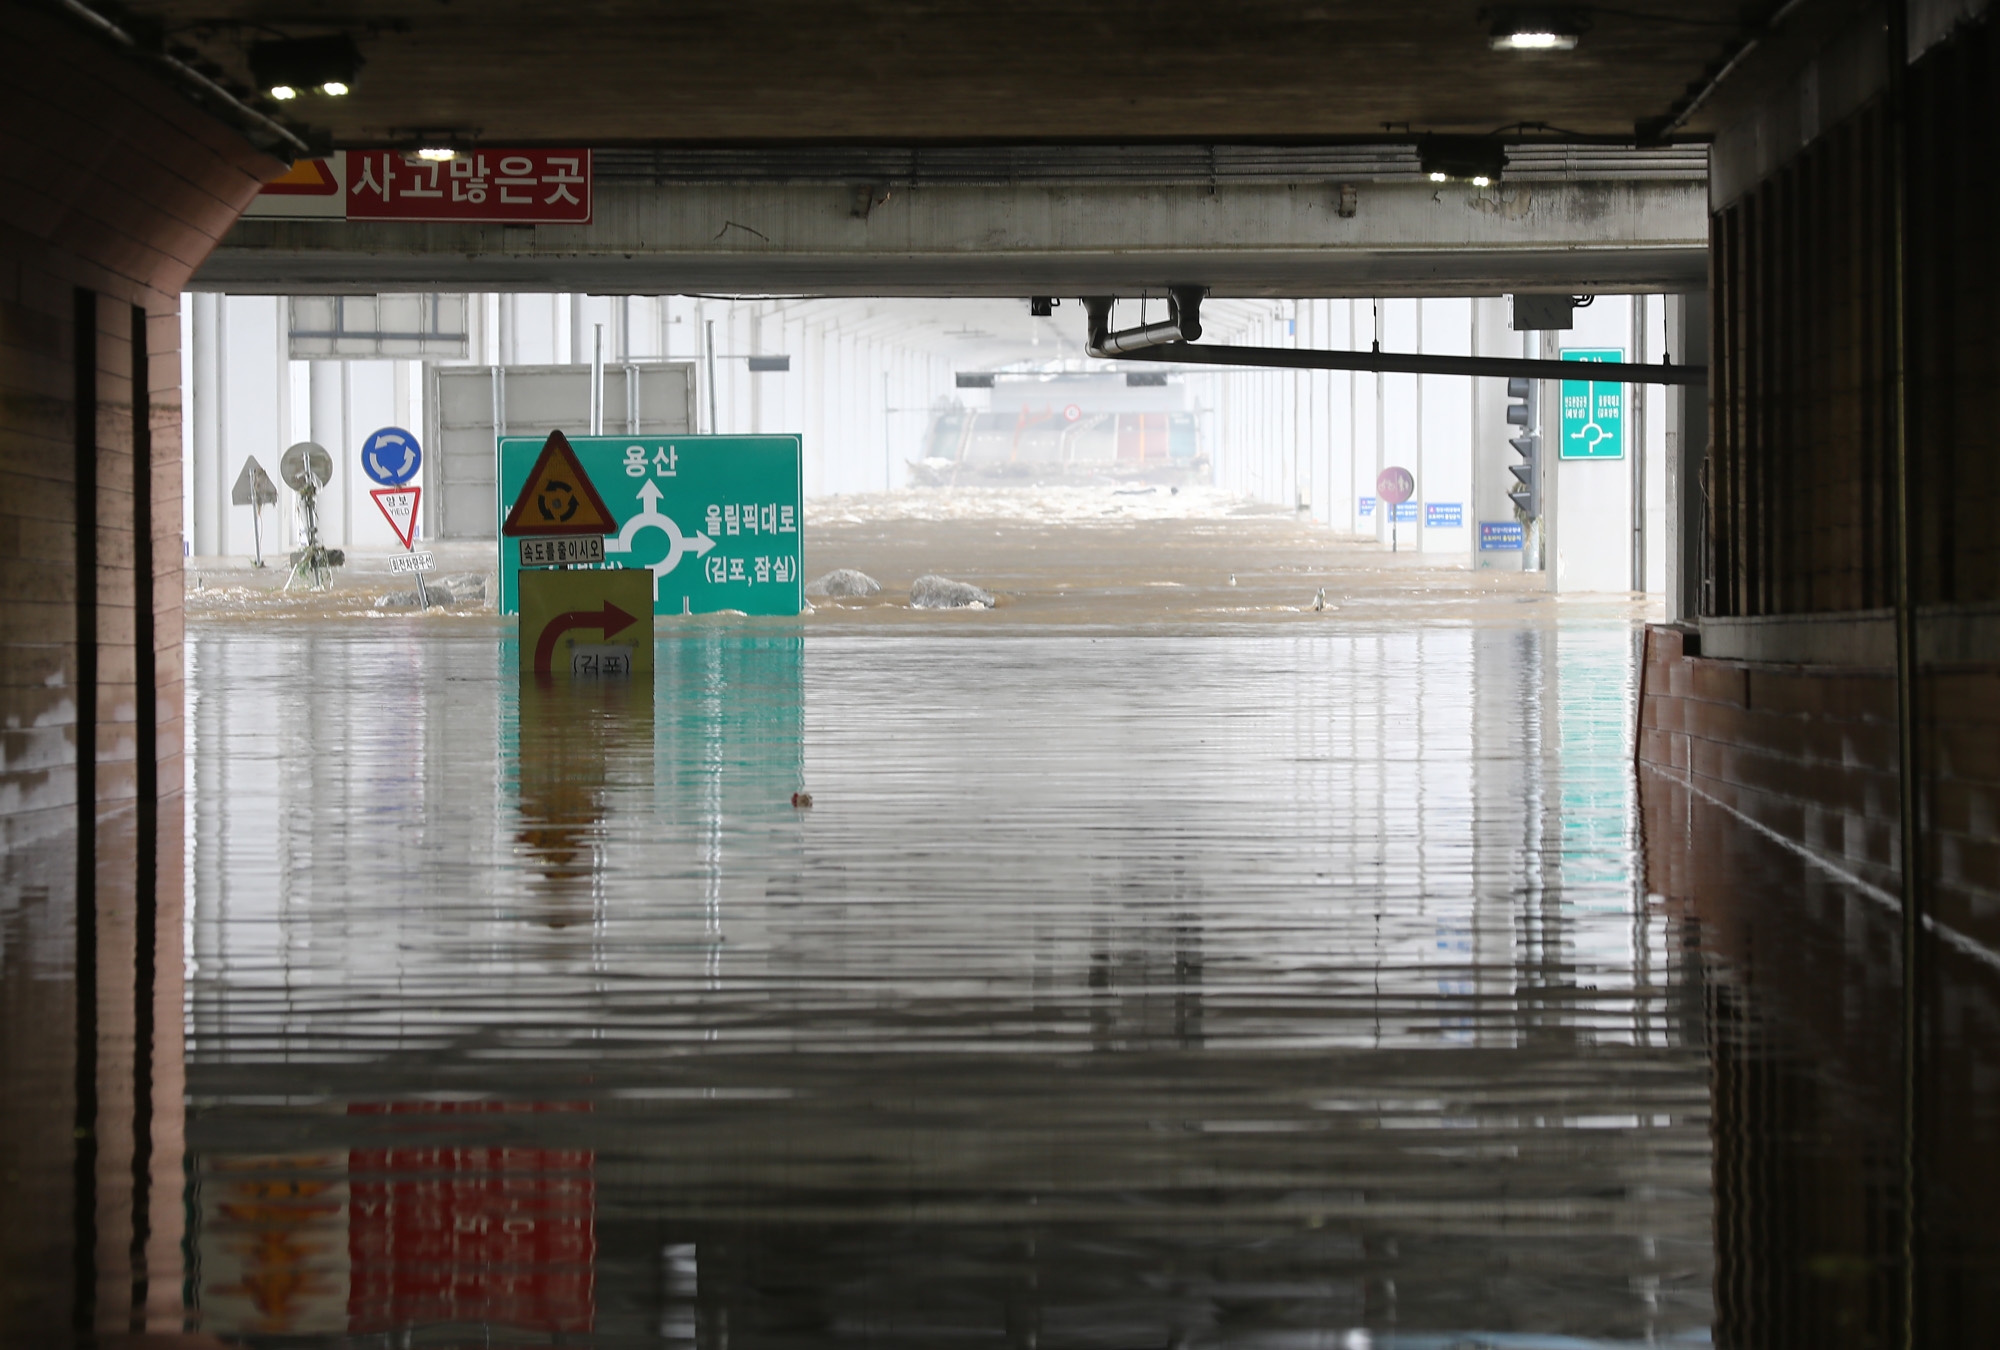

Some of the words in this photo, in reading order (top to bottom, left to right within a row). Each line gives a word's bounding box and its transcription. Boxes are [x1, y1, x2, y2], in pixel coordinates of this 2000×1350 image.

[351, 153, 585, 206] 사고많은곳
[623, 445, 678, 477] 용산
[386, 494, 408, 507] 양보
[390, 508, 410, 516] YIELD
[705, 503, 796, 536] 올림픽대로
[392, 555, 432, 571] 회전차량우선
[524, 540, 600, 562] 속도를줄이시오
[705, 555, 796, 587] (김포,잠실)
